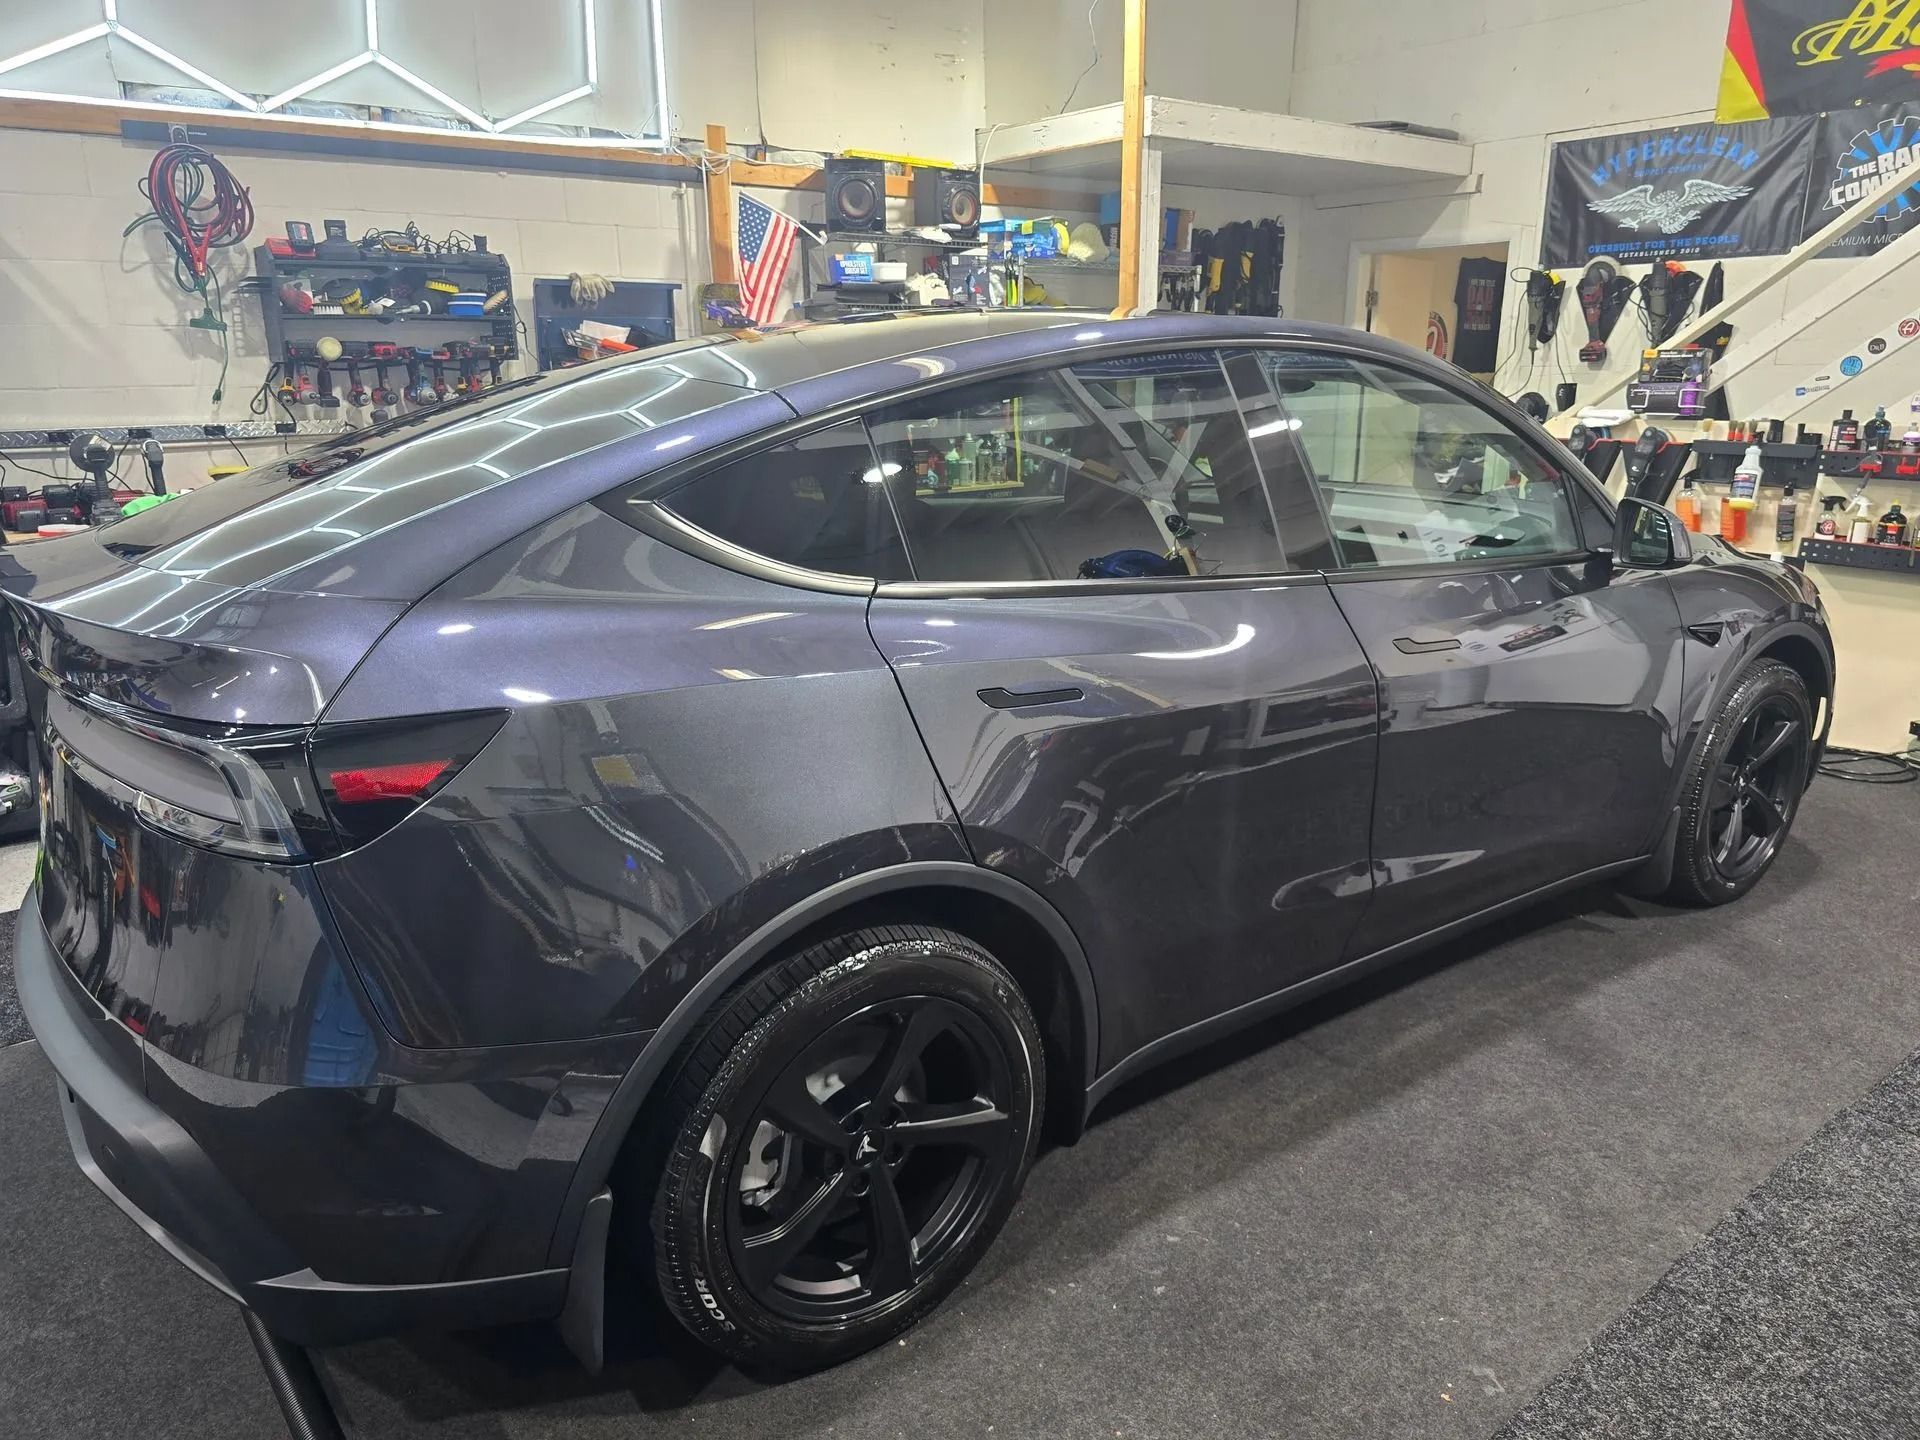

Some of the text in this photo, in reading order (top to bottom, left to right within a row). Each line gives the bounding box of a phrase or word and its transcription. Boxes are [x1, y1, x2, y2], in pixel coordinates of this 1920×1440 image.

[1591, 135, 1759, 187] HYPERCLEAN
[1848, 161, 1877, 179] THE
[1588, 233, 1739, 254] OVERBUILT FOR THE PEOPLE
[1618, 249, 1676, 259] ESTABLISHED
